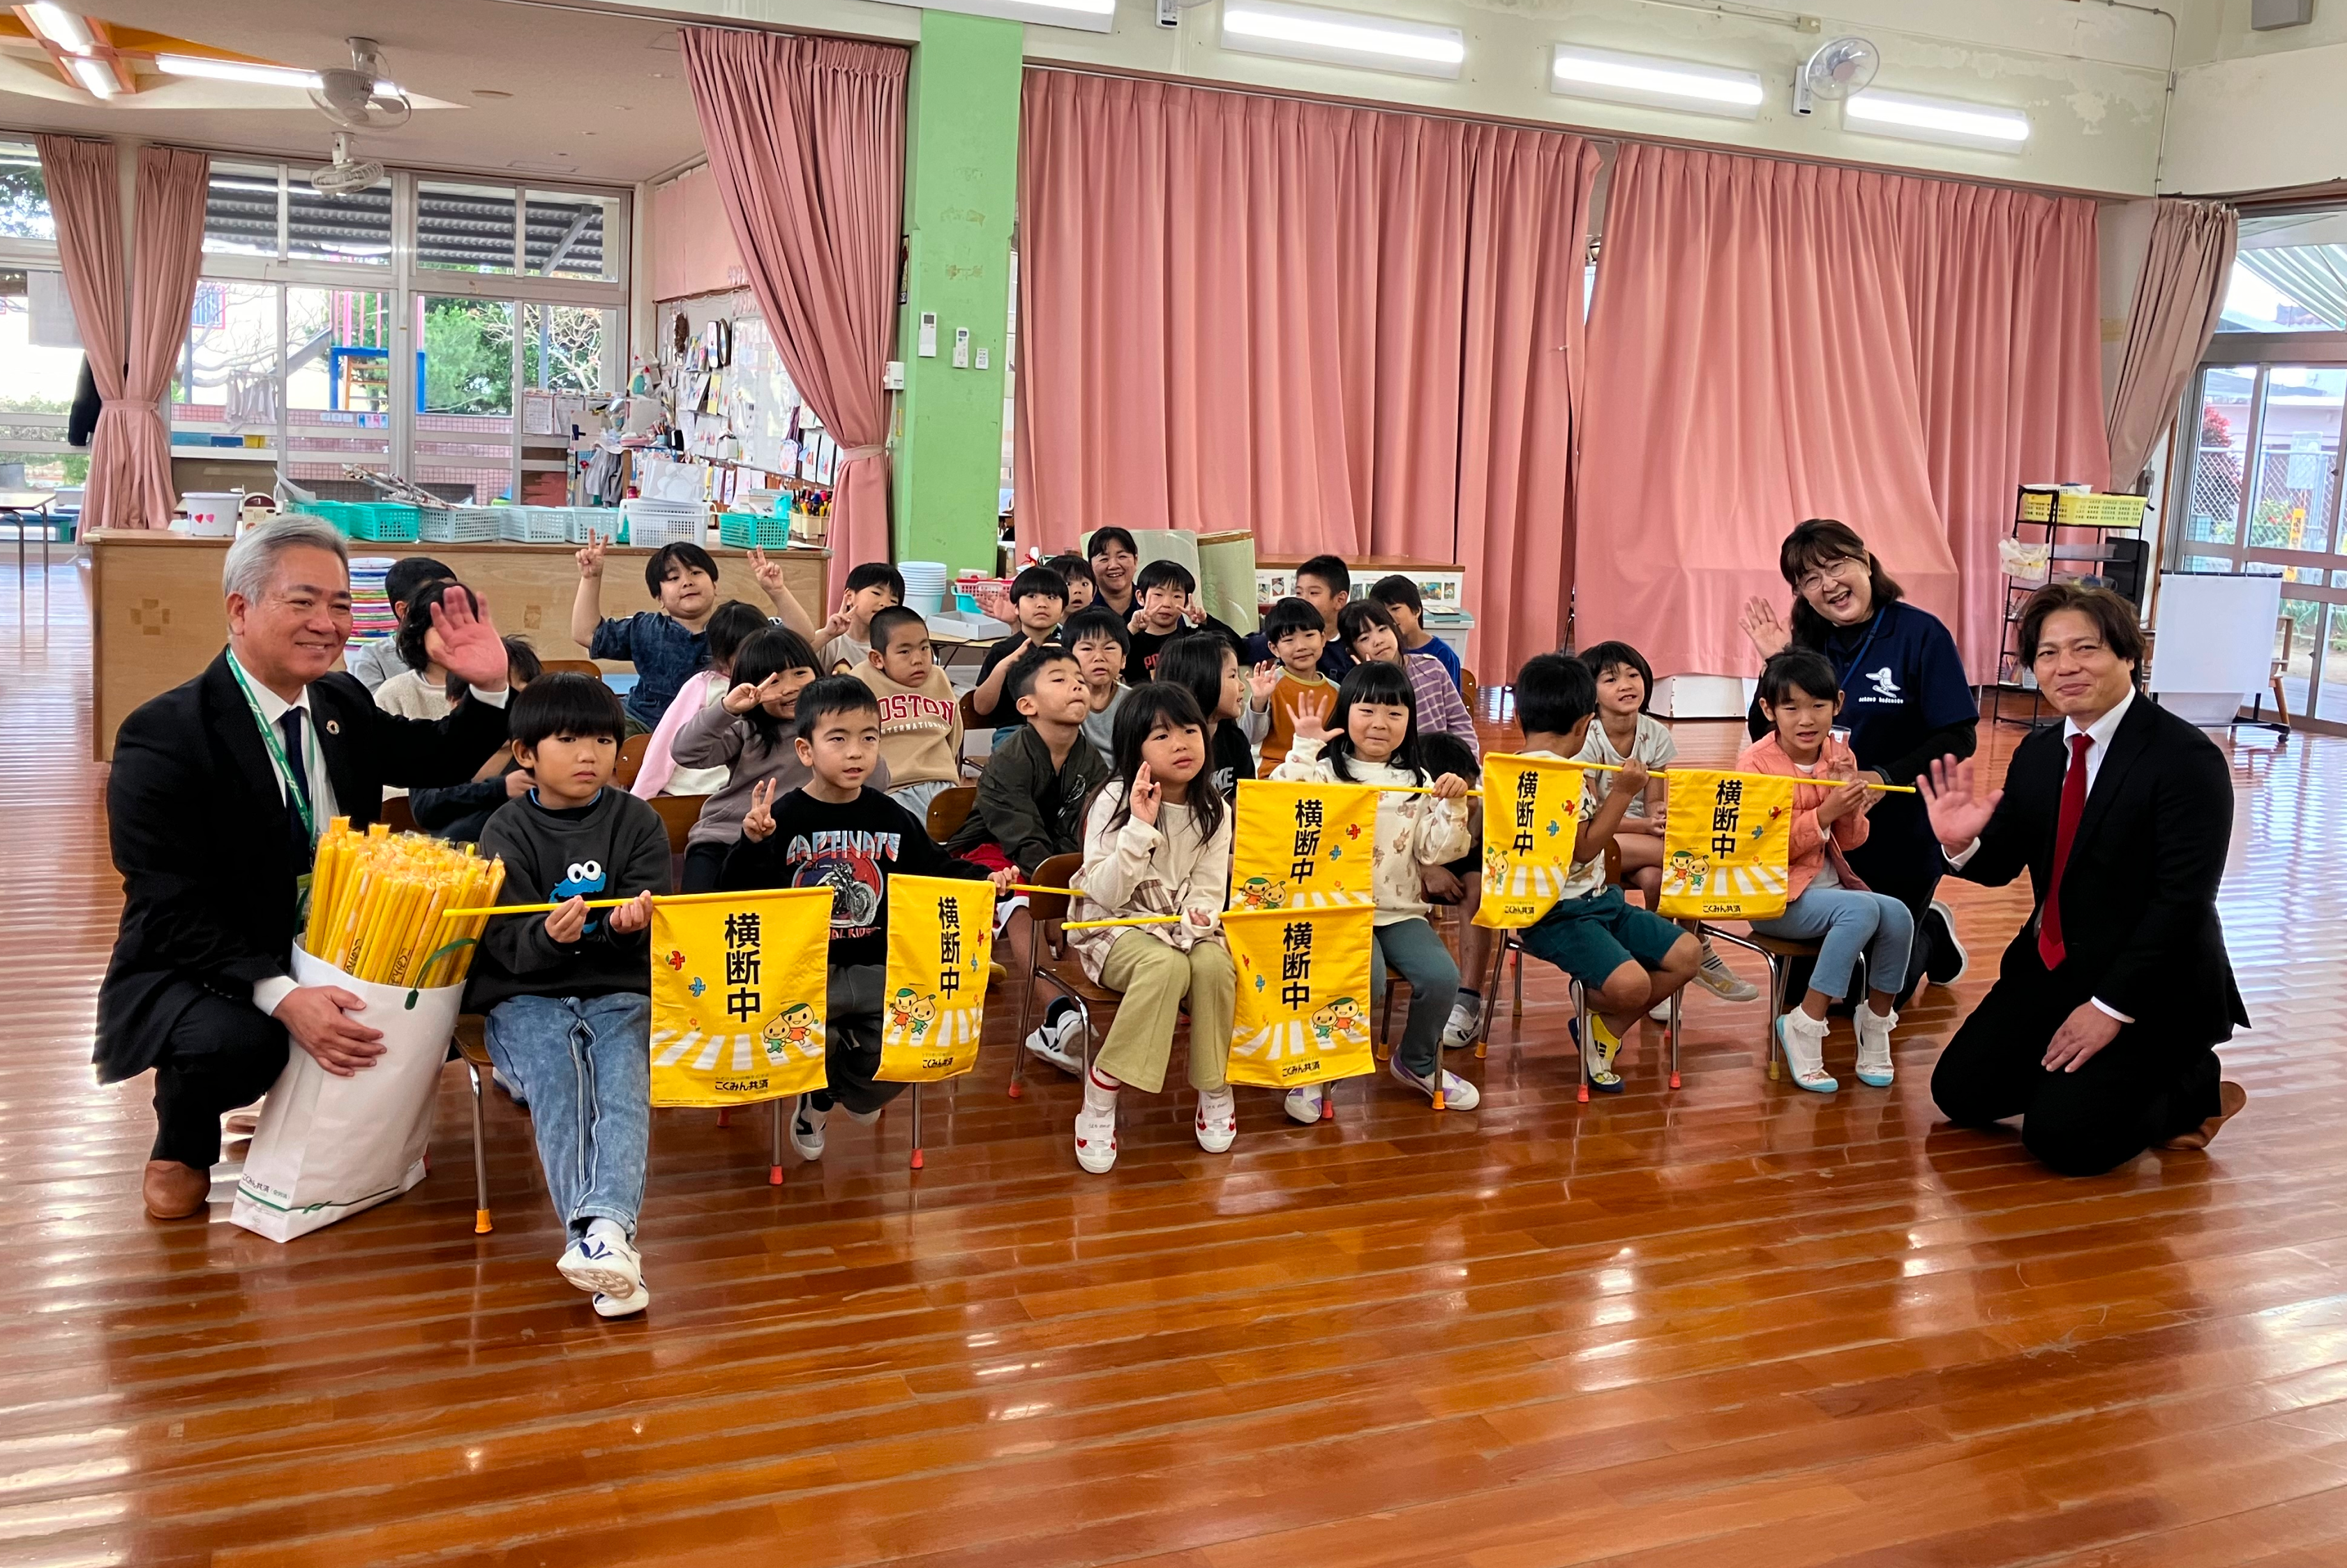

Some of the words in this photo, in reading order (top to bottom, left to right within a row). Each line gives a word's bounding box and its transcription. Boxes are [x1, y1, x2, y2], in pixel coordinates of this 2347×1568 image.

[878, 693, 954, 727] OSTON
[880, 721, 947, 734] NTERNATIONAL
[1210, 767, 1234, 791] KE
[1513, 771, 1538, 857] 横断中
[1711, 779, 1743, 859] 横断中
[786, 830, 901, 866] CAPTIVATE
[1290, 799, 1323, 884] 横断中
[725, 913, 760, 1023] 横断中
[938, 896, 960, 1000] 横断中
[1282, 921, 1312, 1011] 横断中
[715, 1079, 768, 1091] こくみん共済
